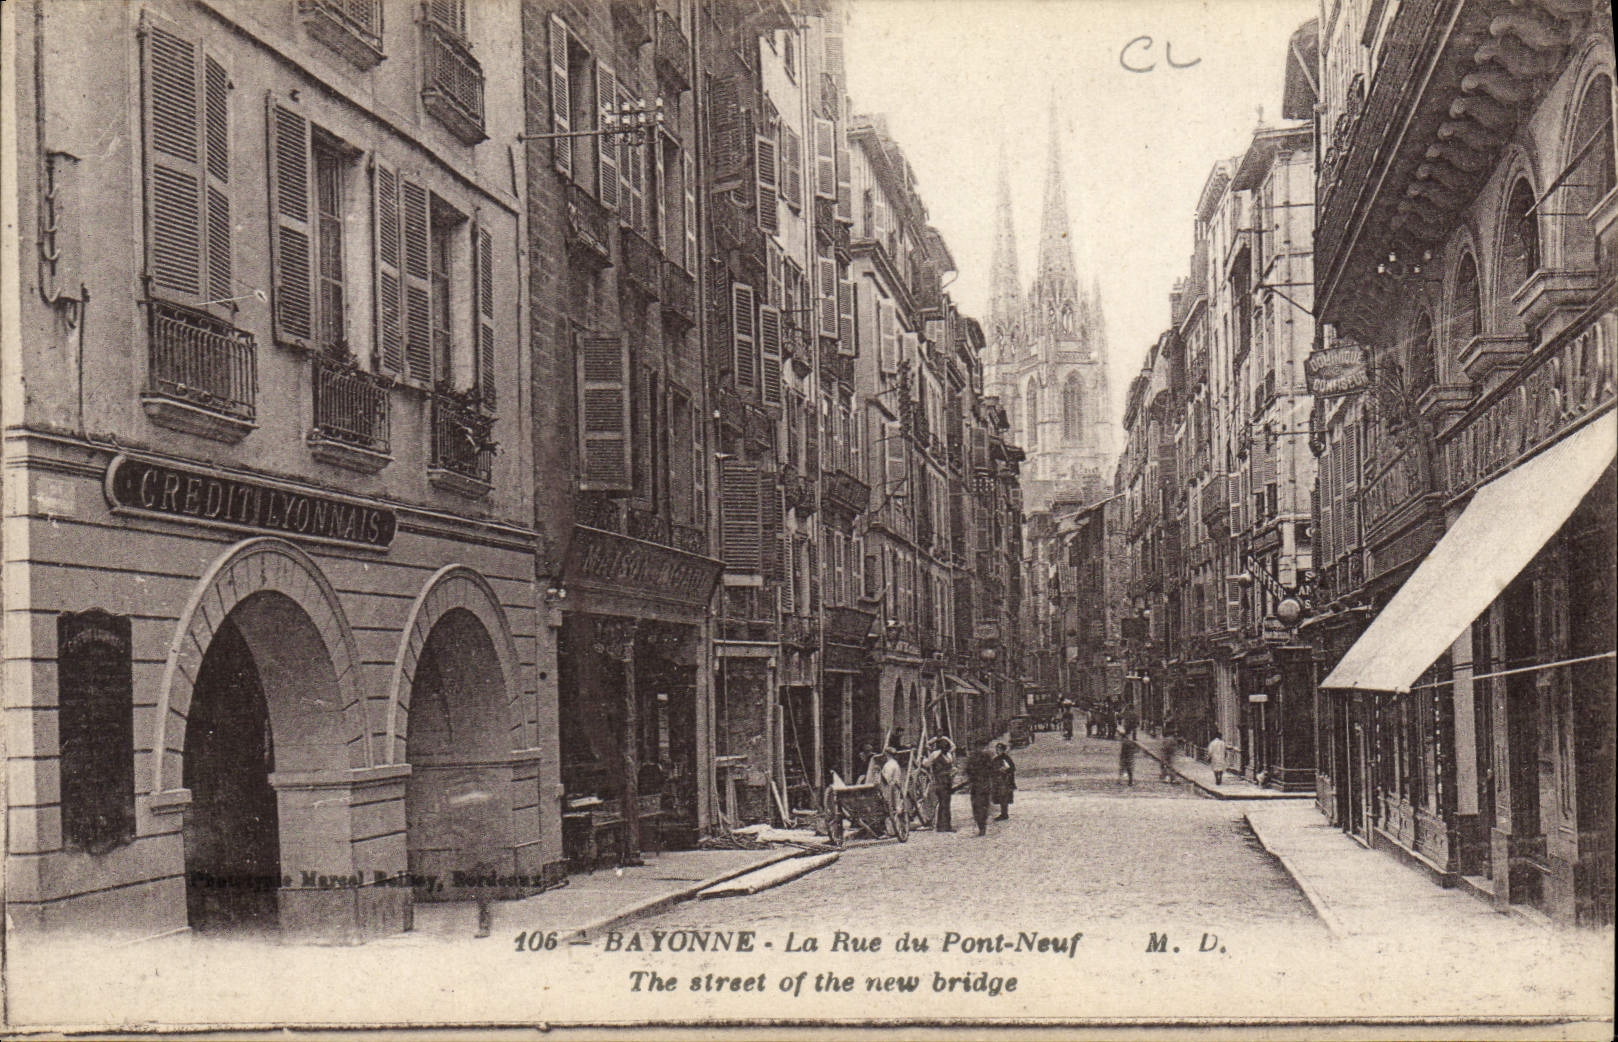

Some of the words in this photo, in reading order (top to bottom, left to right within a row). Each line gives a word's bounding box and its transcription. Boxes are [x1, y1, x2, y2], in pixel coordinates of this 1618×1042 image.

[1309, 350, 1366, 372] DOMINIQUE
[1312, 370, 1369, 393] CONFISEUR
[264, 491, 380, 543] LYONNAIS
[1247, 555, 1287, 602] COIFFEU
